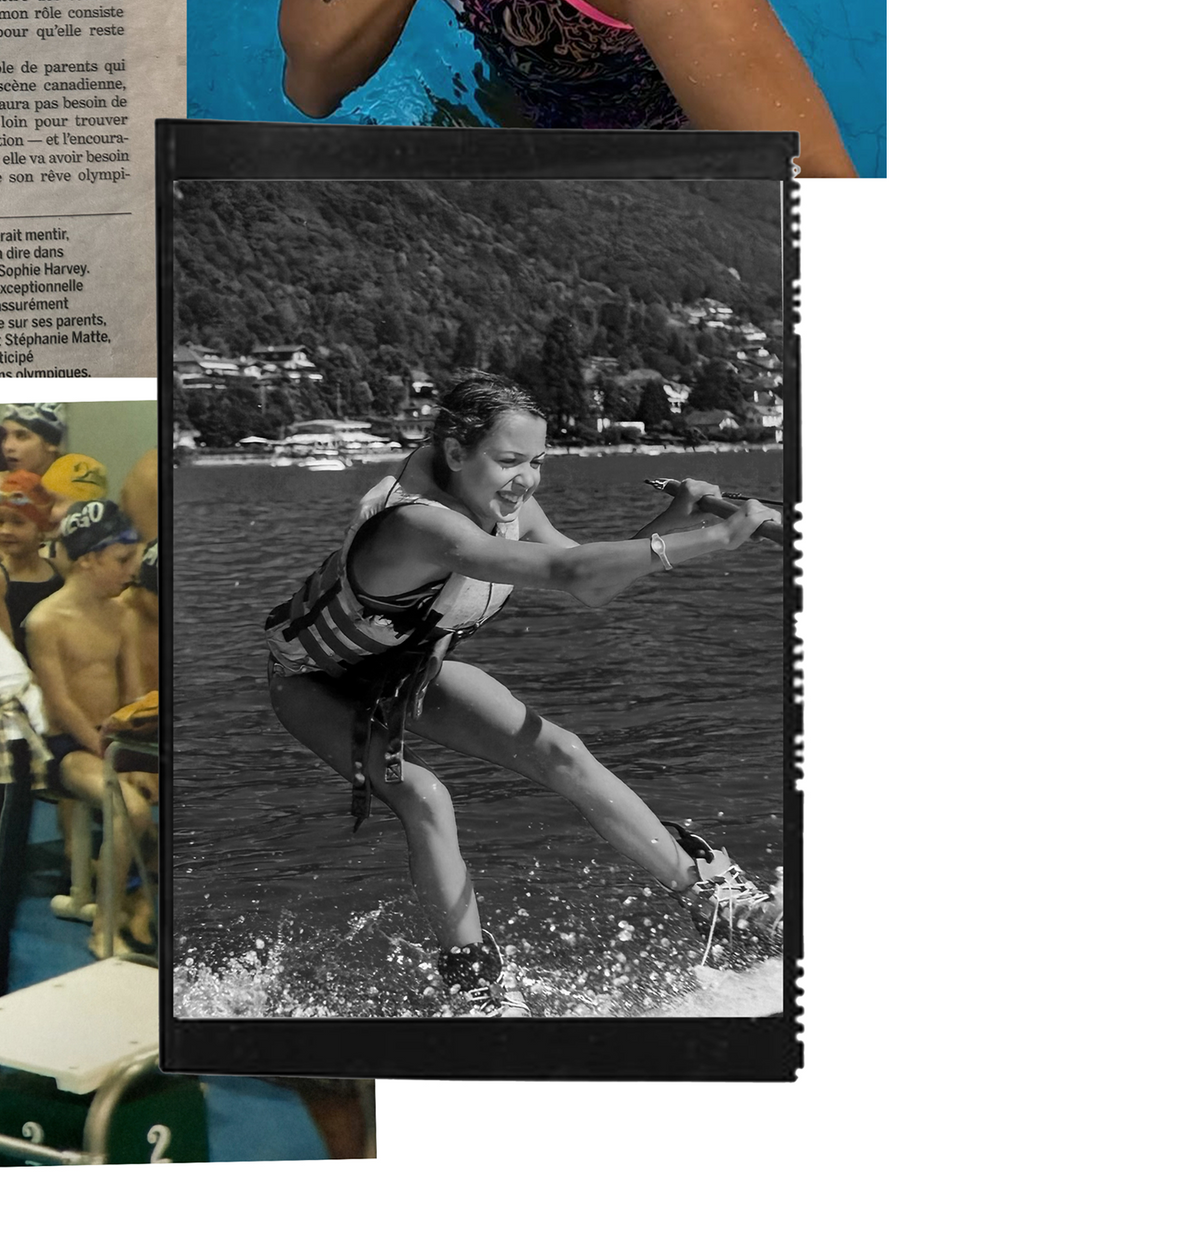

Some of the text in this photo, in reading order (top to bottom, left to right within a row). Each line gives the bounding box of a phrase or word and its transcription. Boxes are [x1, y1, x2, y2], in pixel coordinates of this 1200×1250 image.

[20, 60, 38, 74] de
[43, 60, 99, 77] parents
[103, 58, 126, 75] qui
[24, 226, 70, 242] mentir,
[5, 245, 31, 260] dire
[33, 244, 65, 259] dans
[43, 261, 90, 278] Harvey.
[7, 318, 29, 329] sur
[30, 316, 53, 328] ses
[55, 312, 107, 330] parents,
[4, 331, 69, 349] Stéphanie
[71, 329, 111, 344] Matte,
